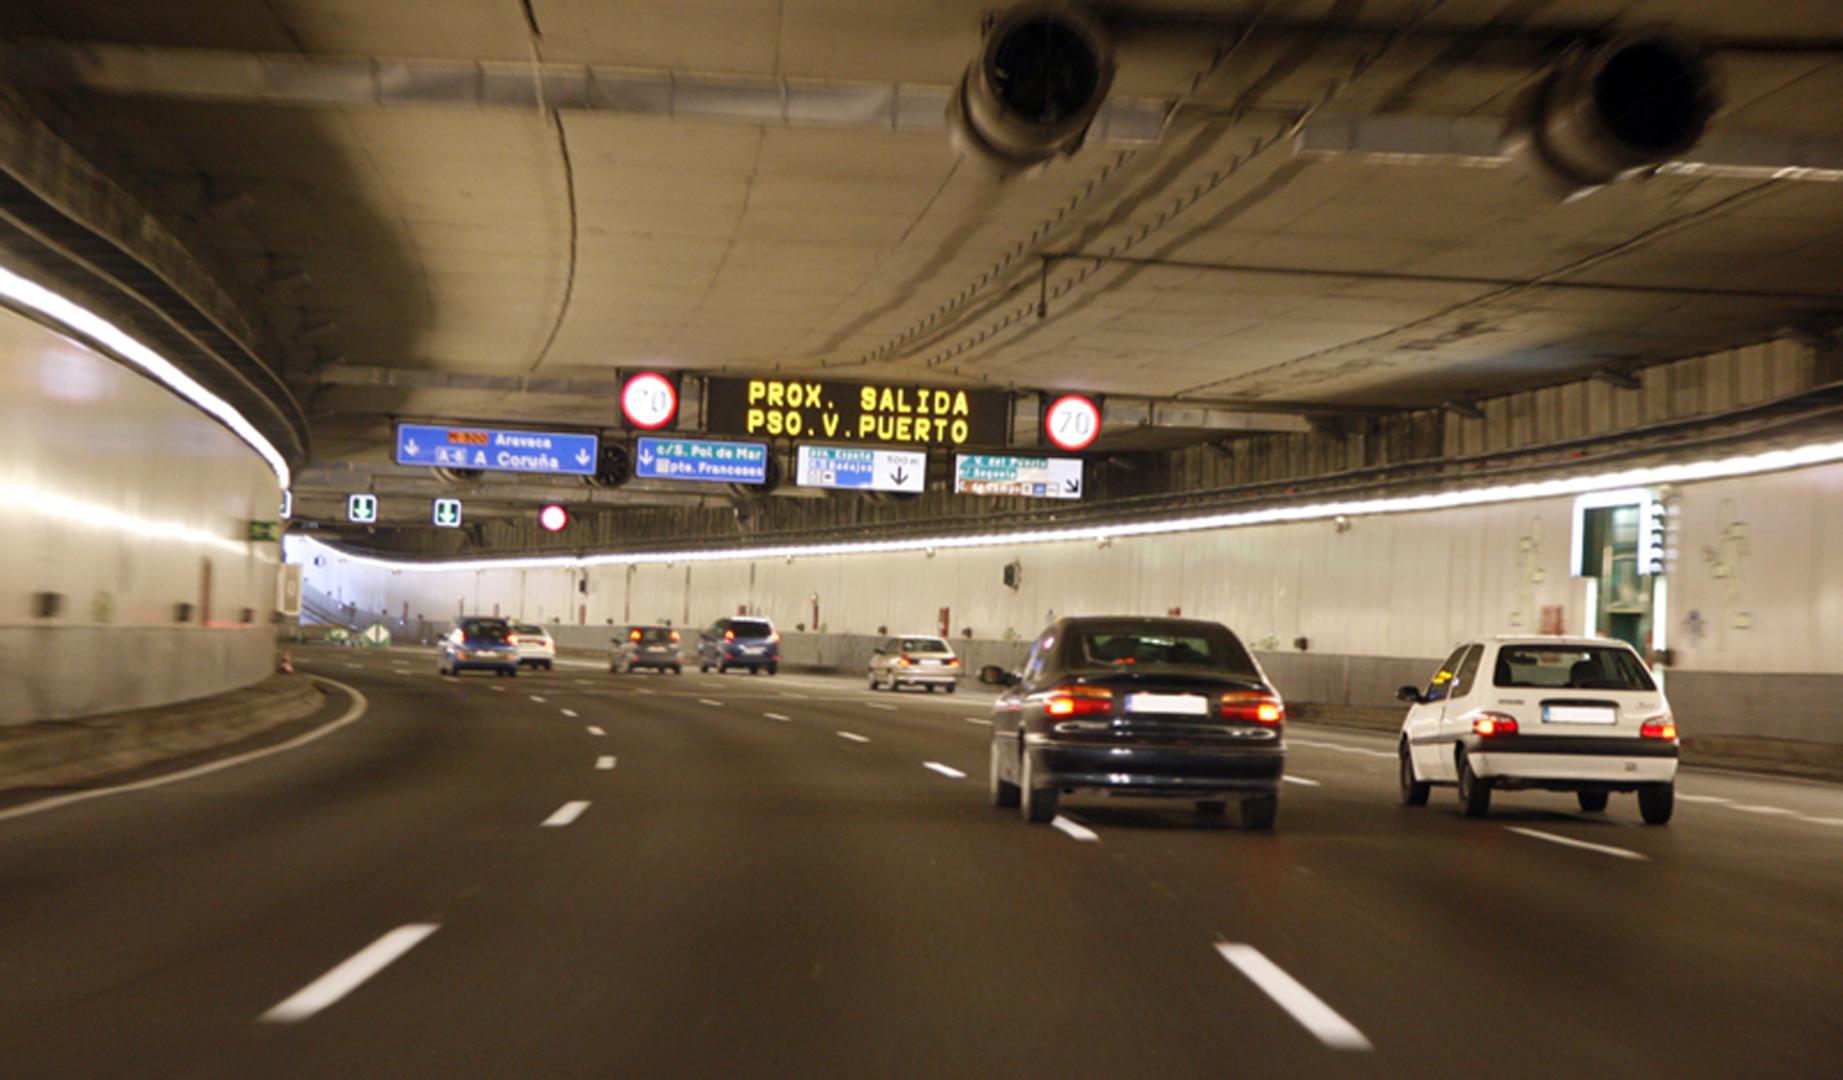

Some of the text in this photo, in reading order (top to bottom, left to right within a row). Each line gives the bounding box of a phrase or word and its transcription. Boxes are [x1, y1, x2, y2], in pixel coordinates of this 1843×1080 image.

[748, 380, 970, 416] PROX. SALIDA
[1059, 410, 1090, 435] 70
[495, 433, 552, 449] Aravaca
[475, 450, 487, 464] A
[497, 451, 559, 469] Coruña
[691, 445, 713, 457] Pol
[716, 446, 733, 459] de
[736, 448, 761, 460] Mar
[698, 462, 763, 477] Franceses
